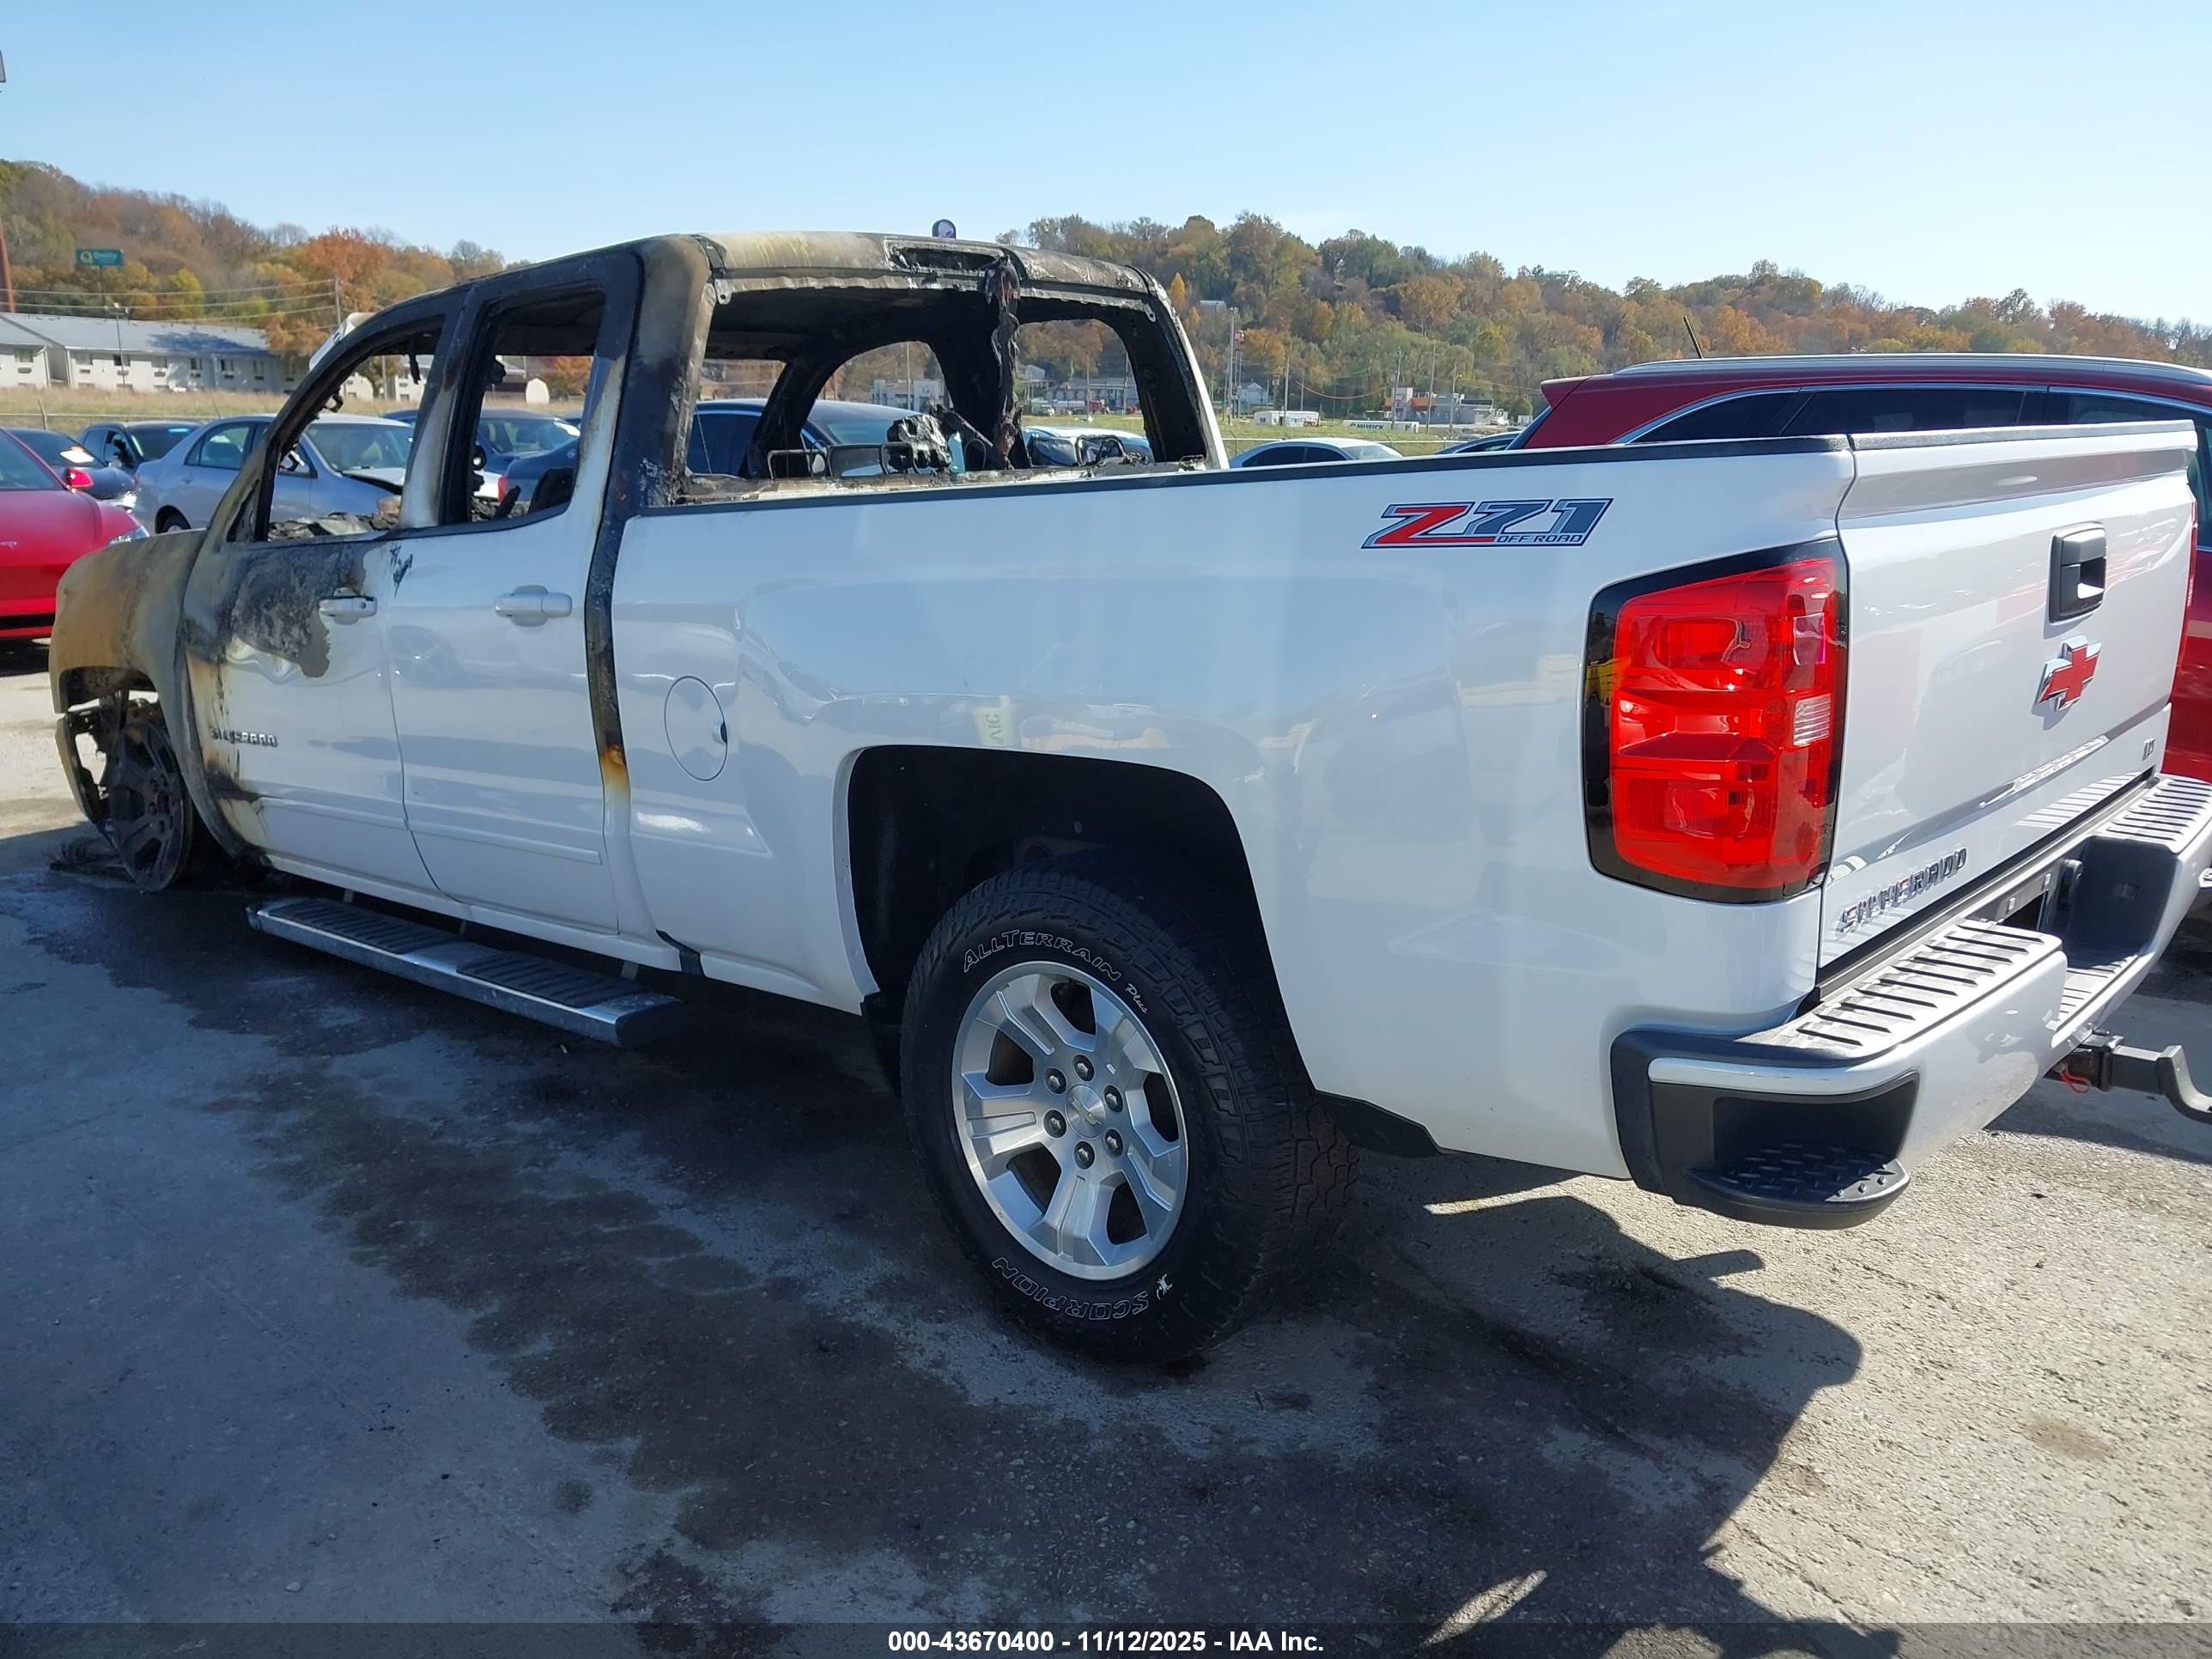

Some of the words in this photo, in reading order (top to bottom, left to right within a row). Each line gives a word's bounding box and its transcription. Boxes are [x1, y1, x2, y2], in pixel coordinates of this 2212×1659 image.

[1360, 497, 1614, 550] Z71
[1496, 534, 1532, 544] OFF
[1534, 533, 1583, 543] ROAD
[963, 929, 1121, 981] ALLTERRAIN
[1125, 982, 1148, 1014] Plus
[991, 1256, 1149, 1320] SCORPION
